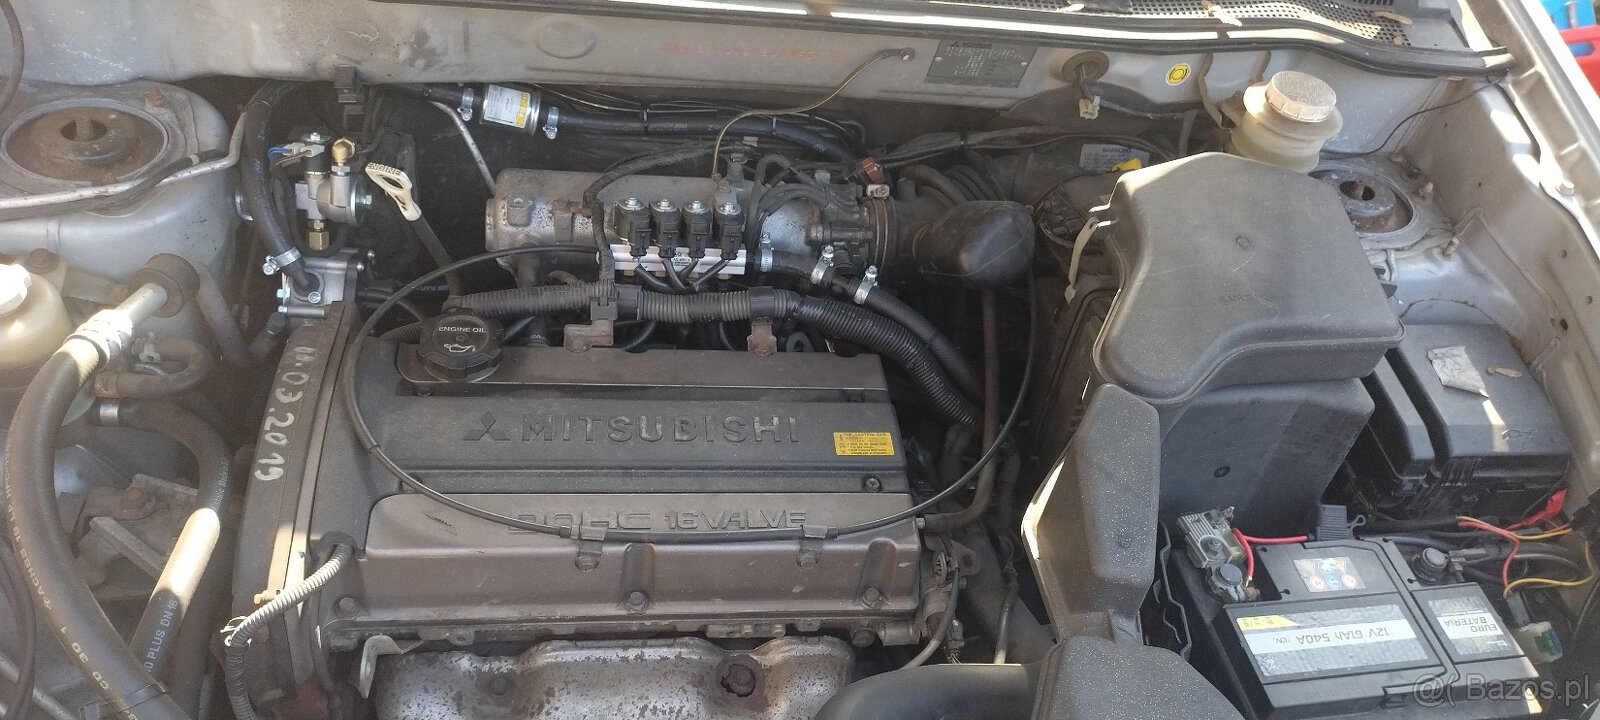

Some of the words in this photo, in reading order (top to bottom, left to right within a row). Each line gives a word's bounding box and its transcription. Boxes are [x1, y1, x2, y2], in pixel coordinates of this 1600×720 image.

[366, 162, 402, 176] ENGINE
[472, 326, 487, 334] OIL
[521, 415, 800, 443] MITSUBISHI
[1444, 616, 1488, 627] BATERIA
[1368, 627, 1391, 638] 12V
[1470, 623, 1498, 633] EURO
[146, 629, 166, 660] PLUS
[160, 610, 175, 627] DN
[1295, 633, 1331, 645] 540A
[1334, 629, 1364, 641] 61Ah
